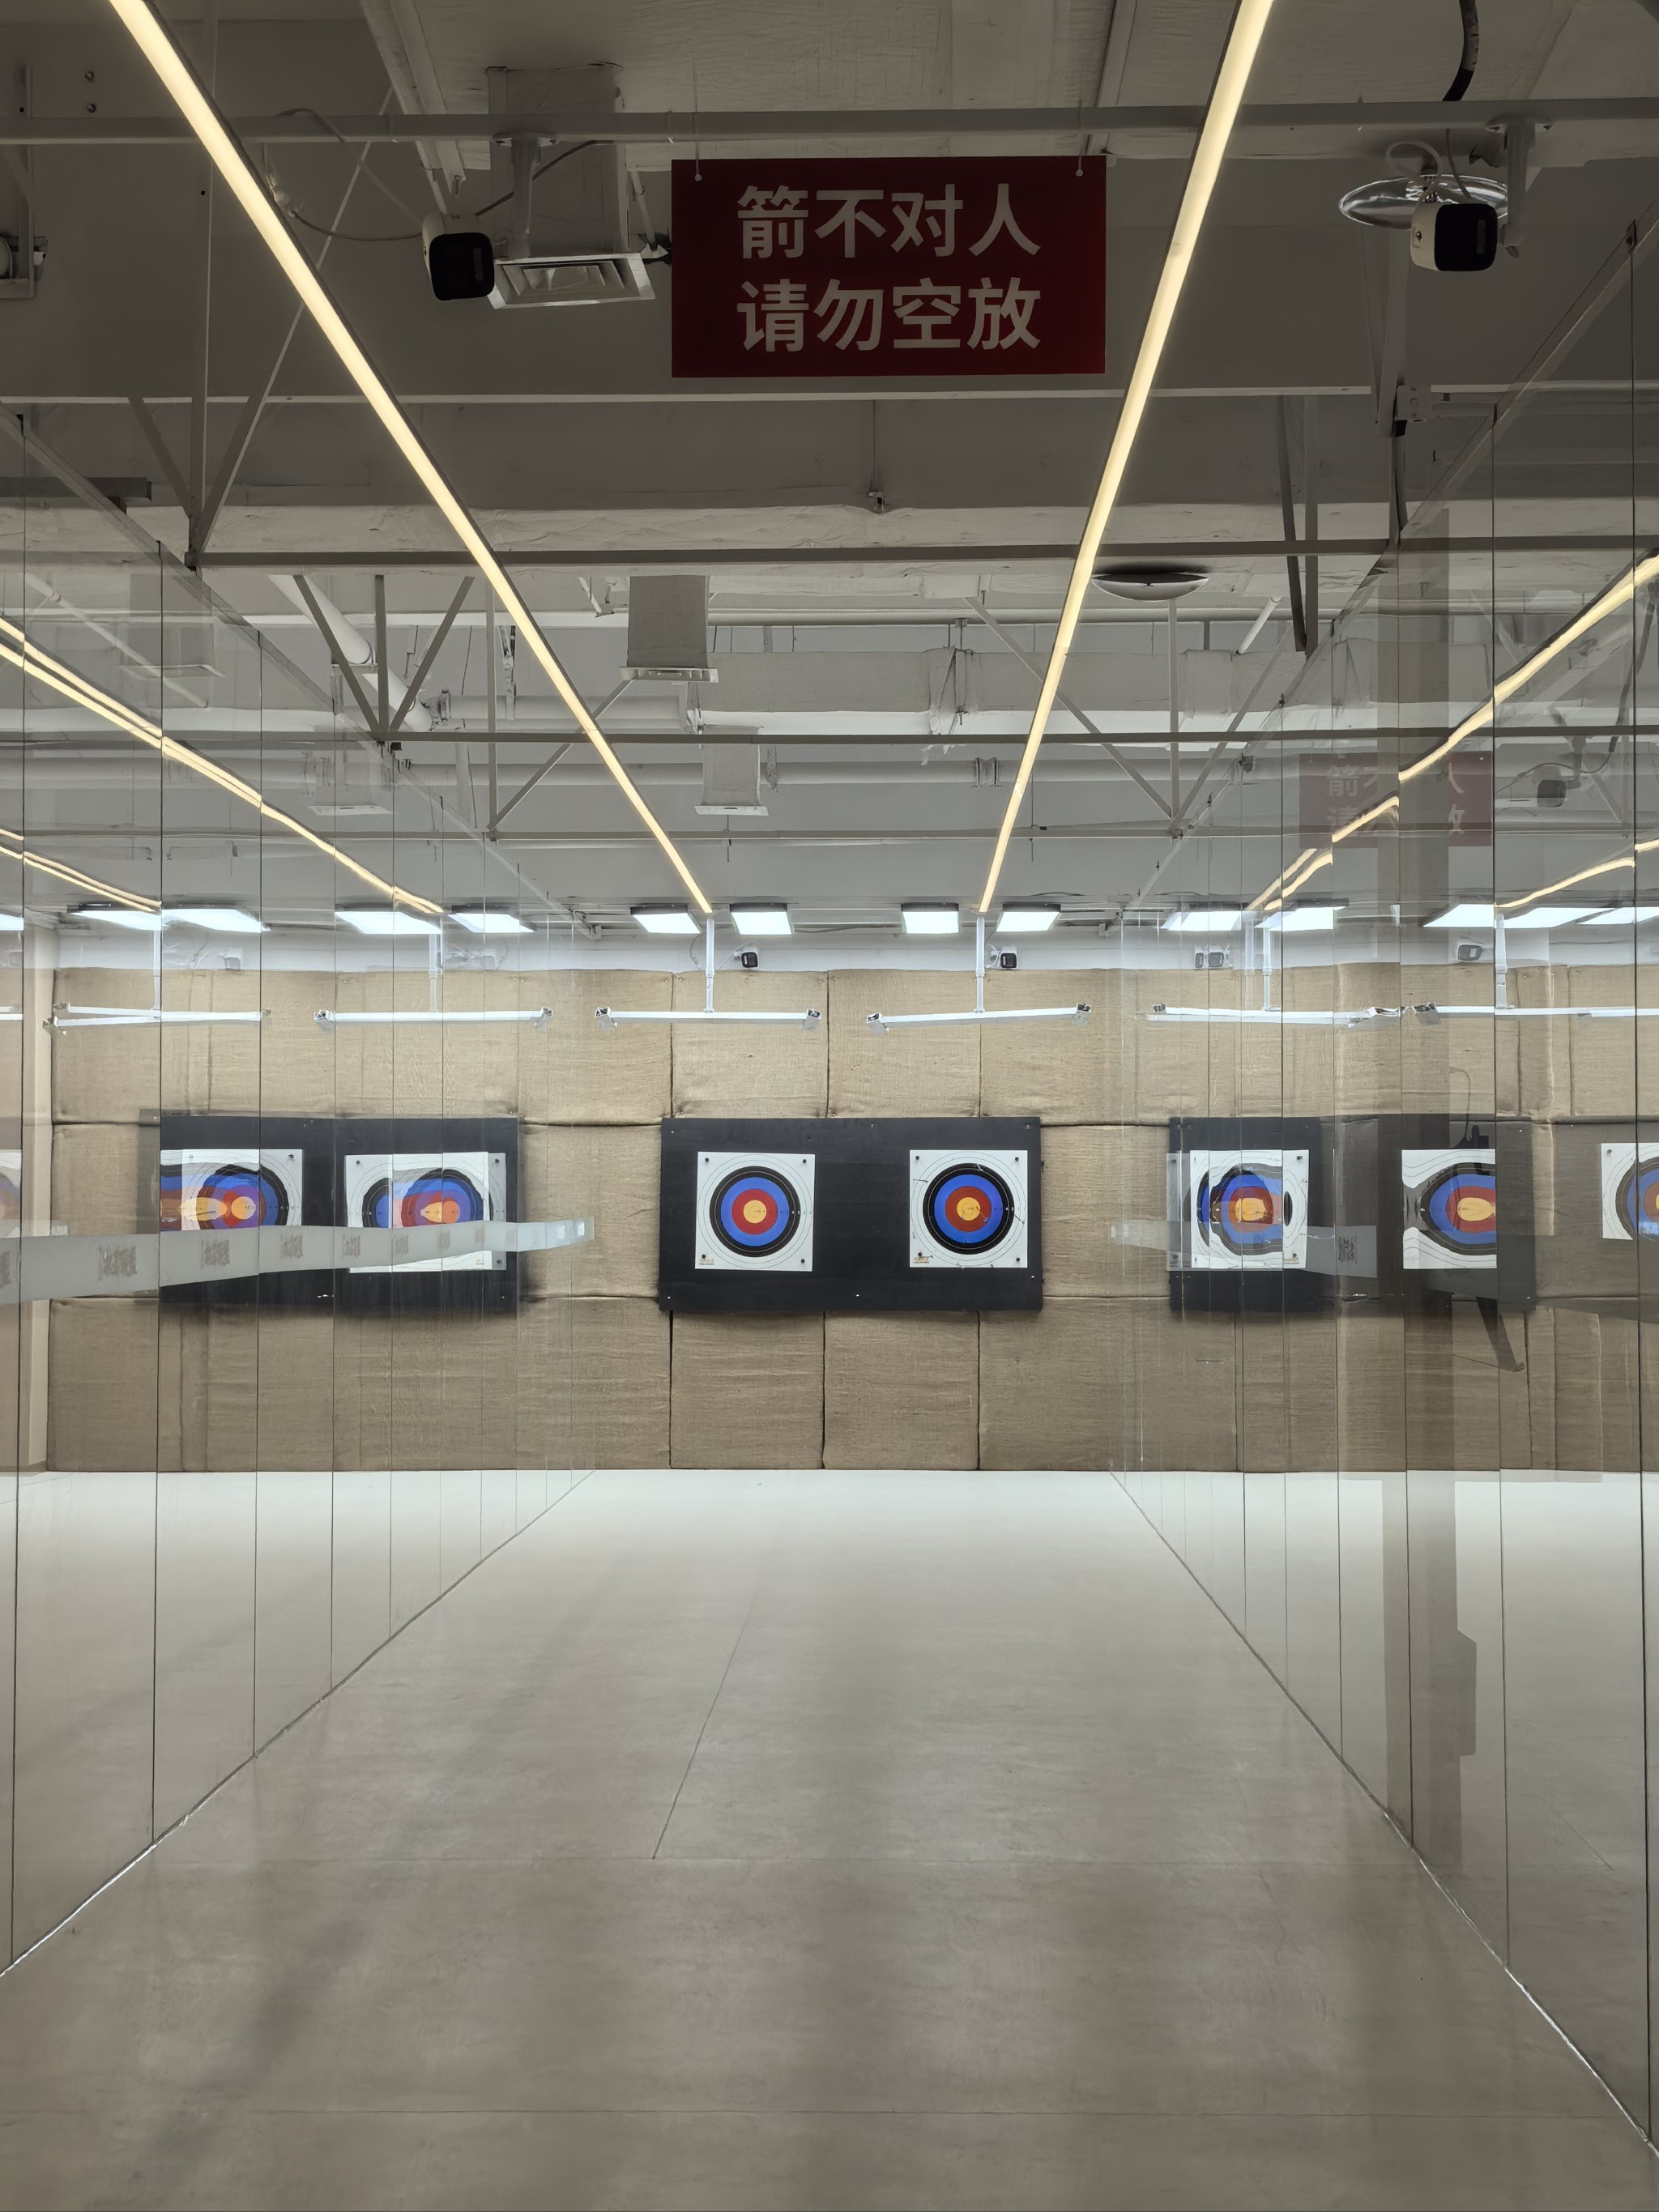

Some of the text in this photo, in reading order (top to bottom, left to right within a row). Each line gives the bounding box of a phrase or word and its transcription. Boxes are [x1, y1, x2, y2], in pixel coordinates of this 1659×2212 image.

[737, 183, 1041, 259] 箭不对人
[736, 276, 1041, 352] 请勿空放
